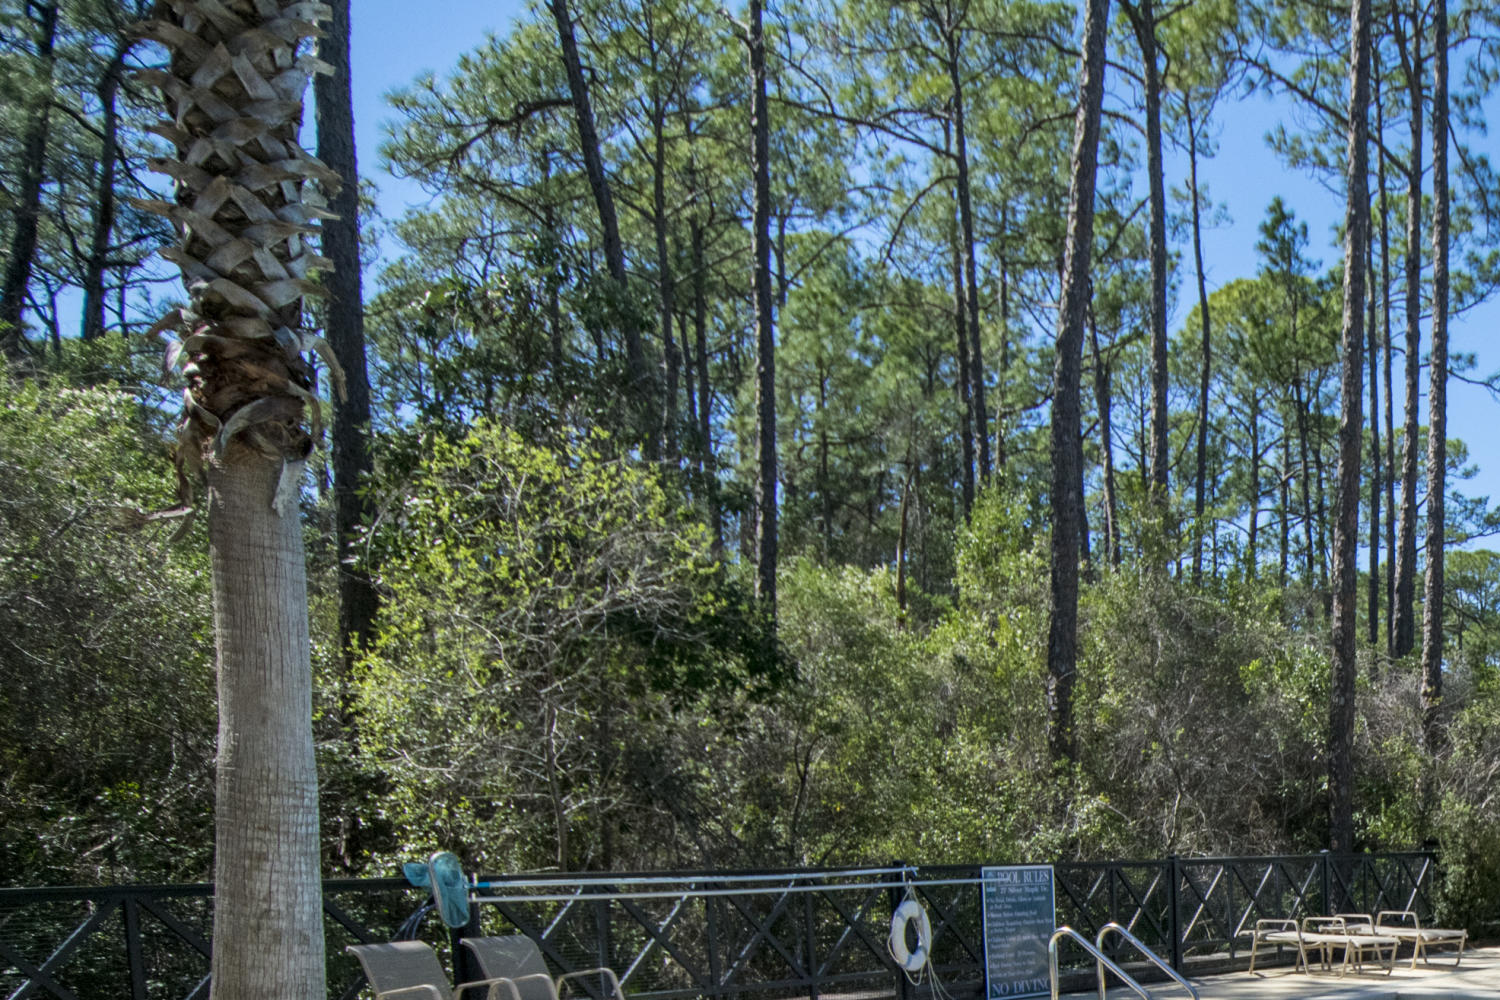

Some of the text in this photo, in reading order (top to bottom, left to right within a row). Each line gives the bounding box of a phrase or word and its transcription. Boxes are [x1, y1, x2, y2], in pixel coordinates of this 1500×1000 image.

[997, 870, 1049, 884] POOL RULES
[992, 983, 1009, 996] NO
